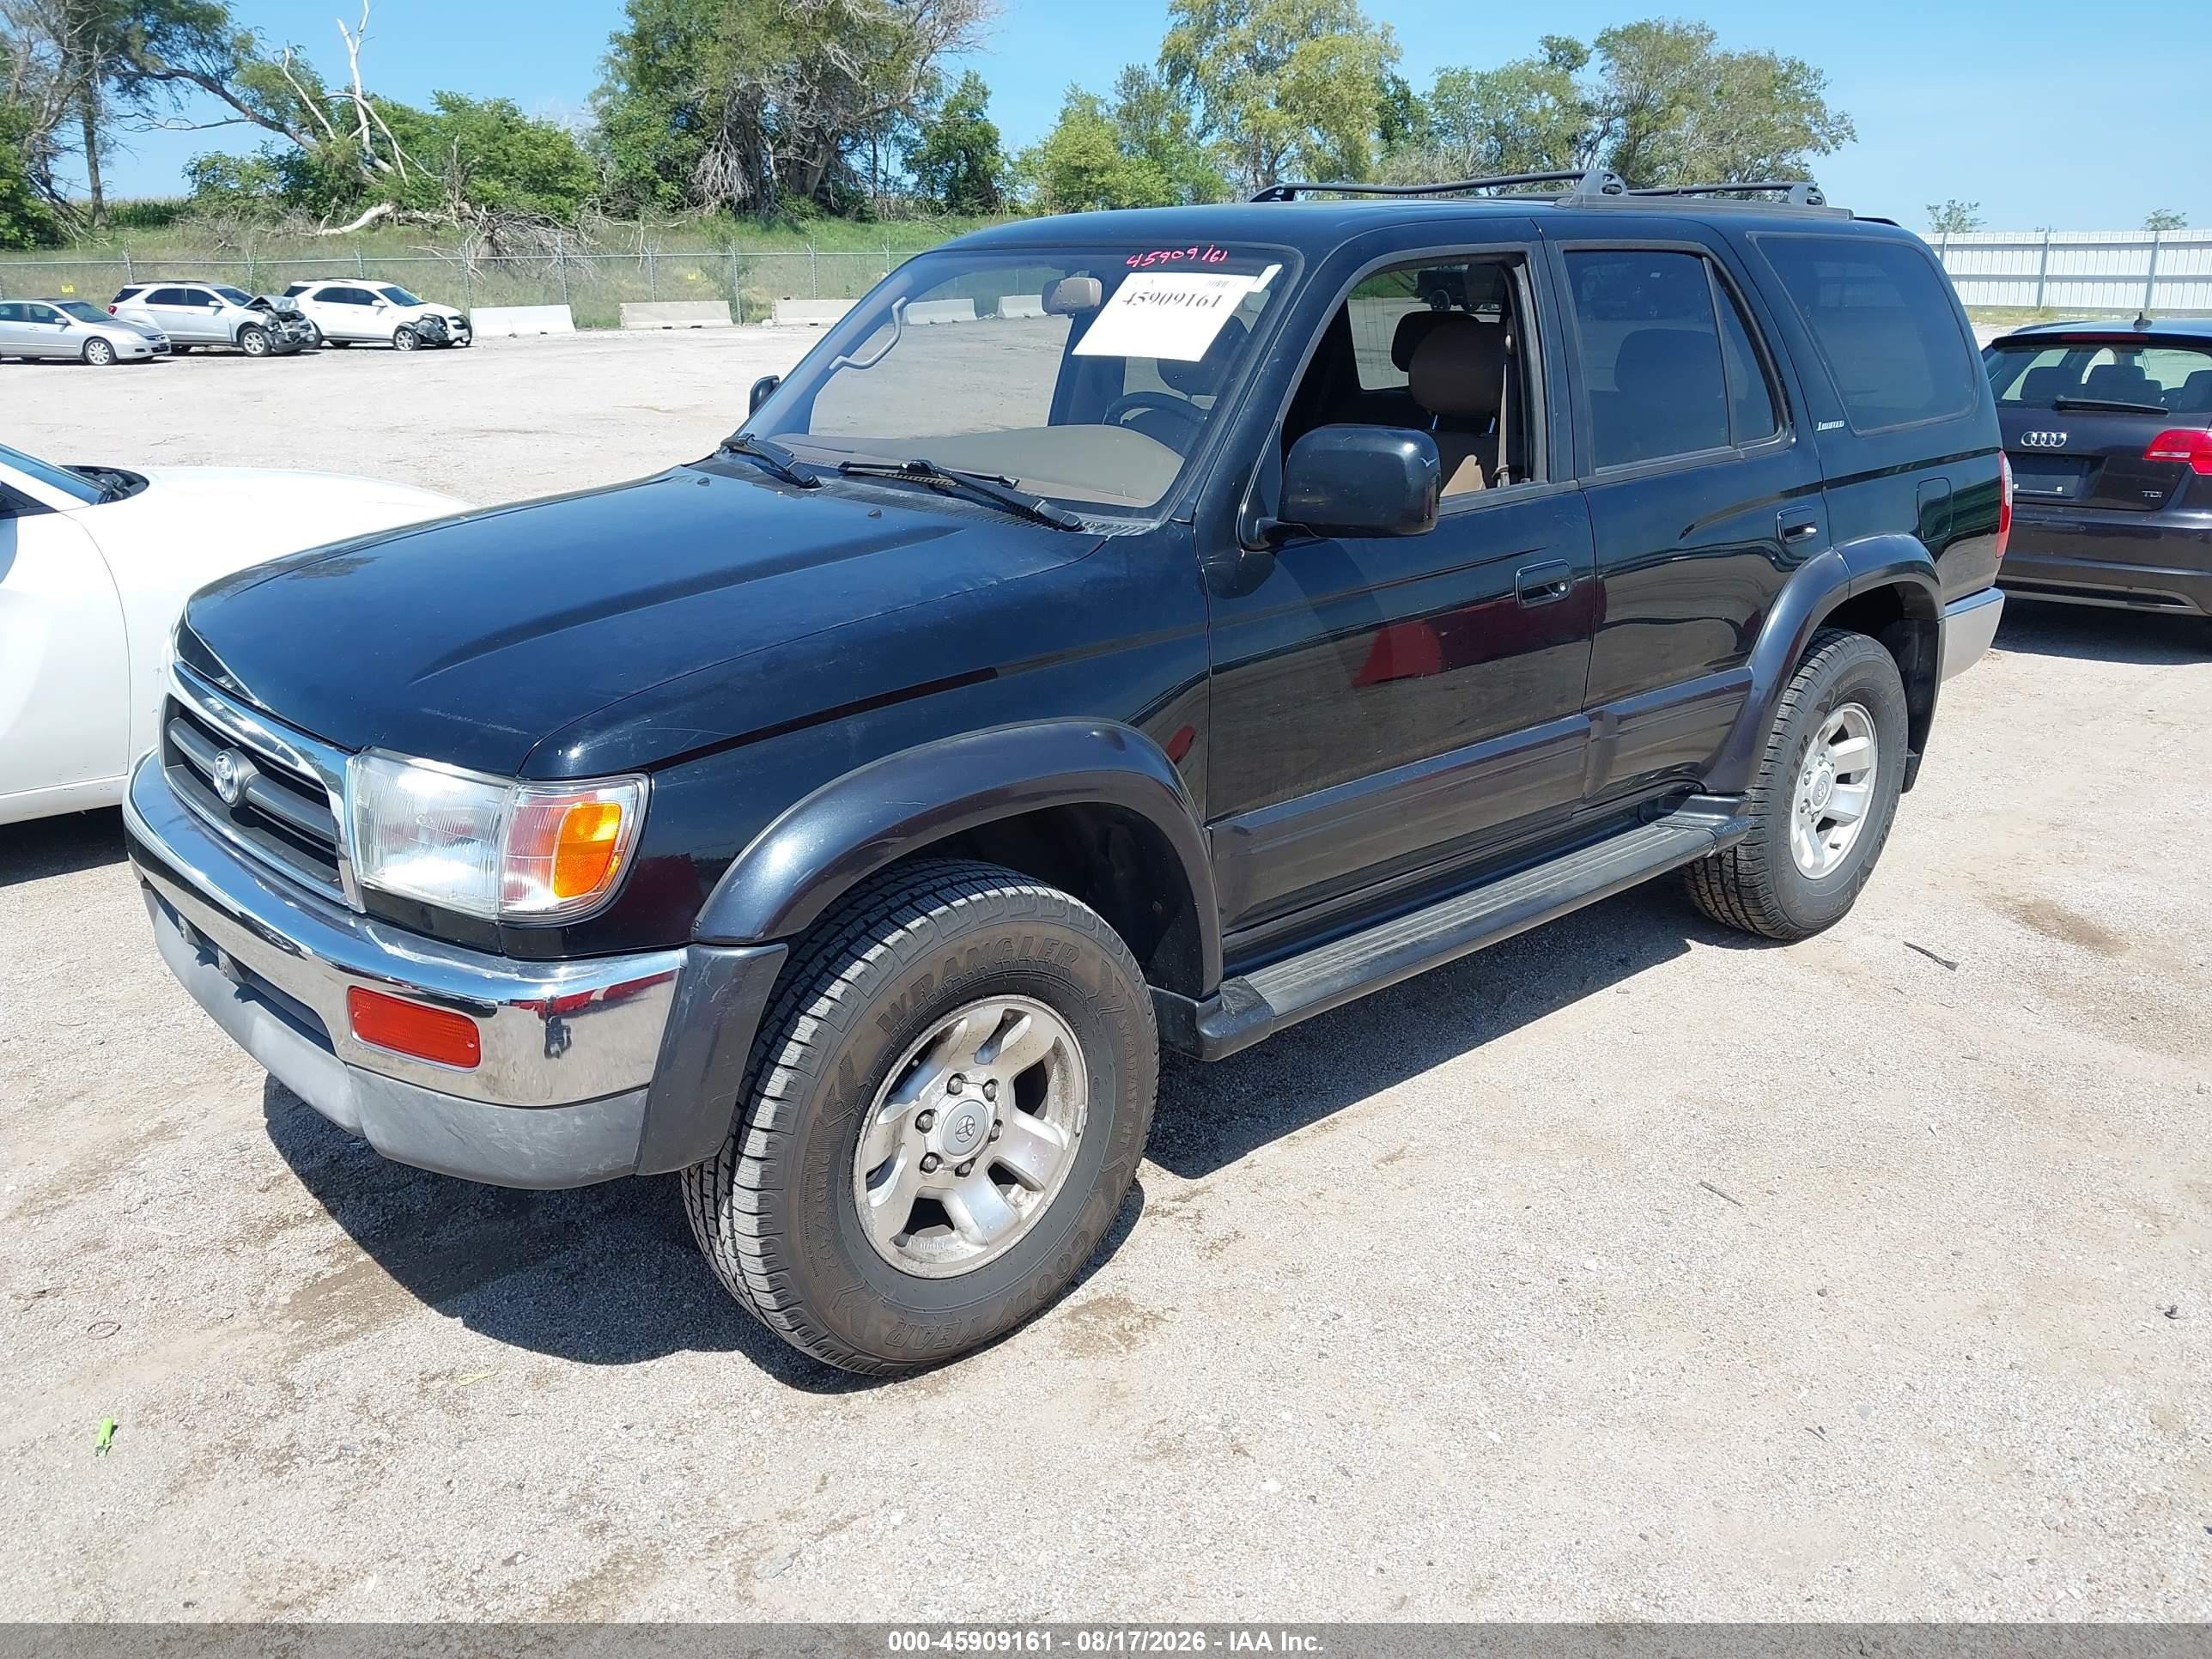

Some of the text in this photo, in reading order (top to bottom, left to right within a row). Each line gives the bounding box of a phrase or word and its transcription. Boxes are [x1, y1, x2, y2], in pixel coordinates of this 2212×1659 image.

[1126, 244, 1228, 268] 45909161
[1122, 291, 1223, 308] 45909161
[874, 935, 1081, 1039] WRANGLER
[884, 1229, 1091, 1351] GOODYEAR
